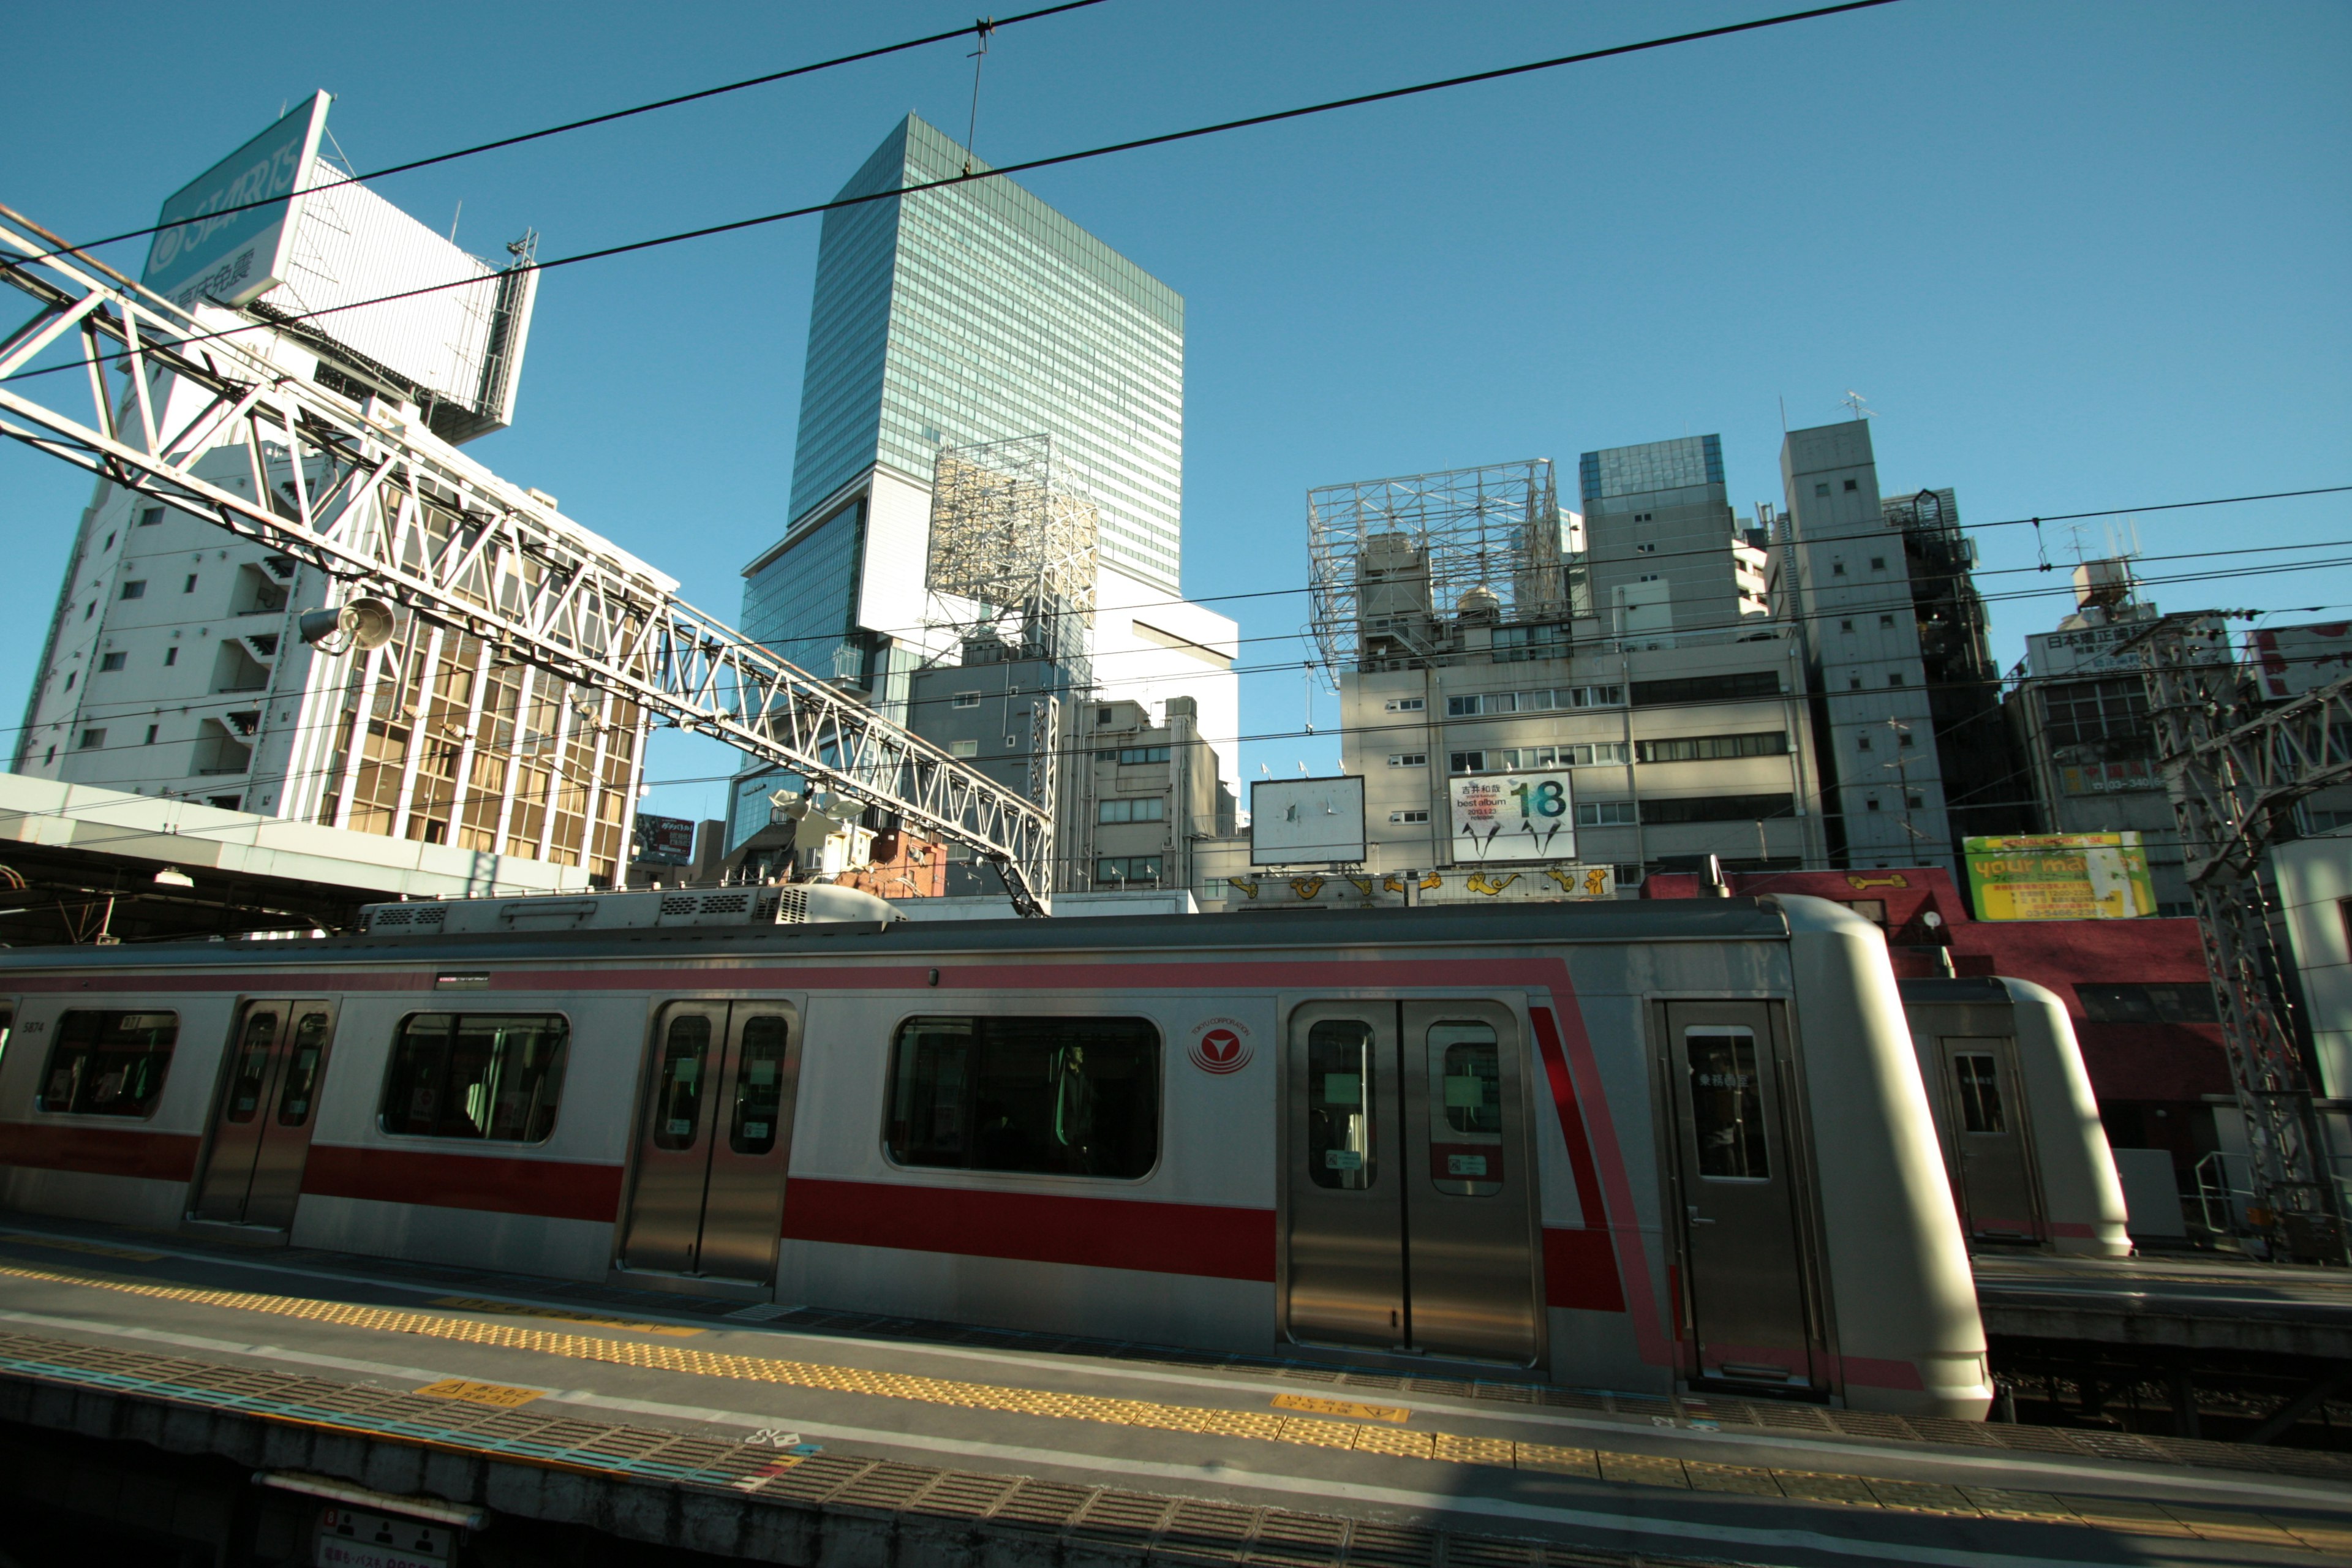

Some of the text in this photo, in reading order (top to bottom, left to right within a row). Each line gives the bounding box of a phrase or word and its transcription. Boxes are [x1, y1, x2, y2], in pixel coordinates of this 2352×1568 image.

[185, 137, 299, 252] STARTS
[1462, 785, 1501, 794] 吉井和哉
[1510, 780, 1566, 818] 18
[1974, 858, 2035, 879] your
[1191, 1017, 1251, 1036] TOKYU CORPORATION
[328, 1511, 334, 1523] 8
